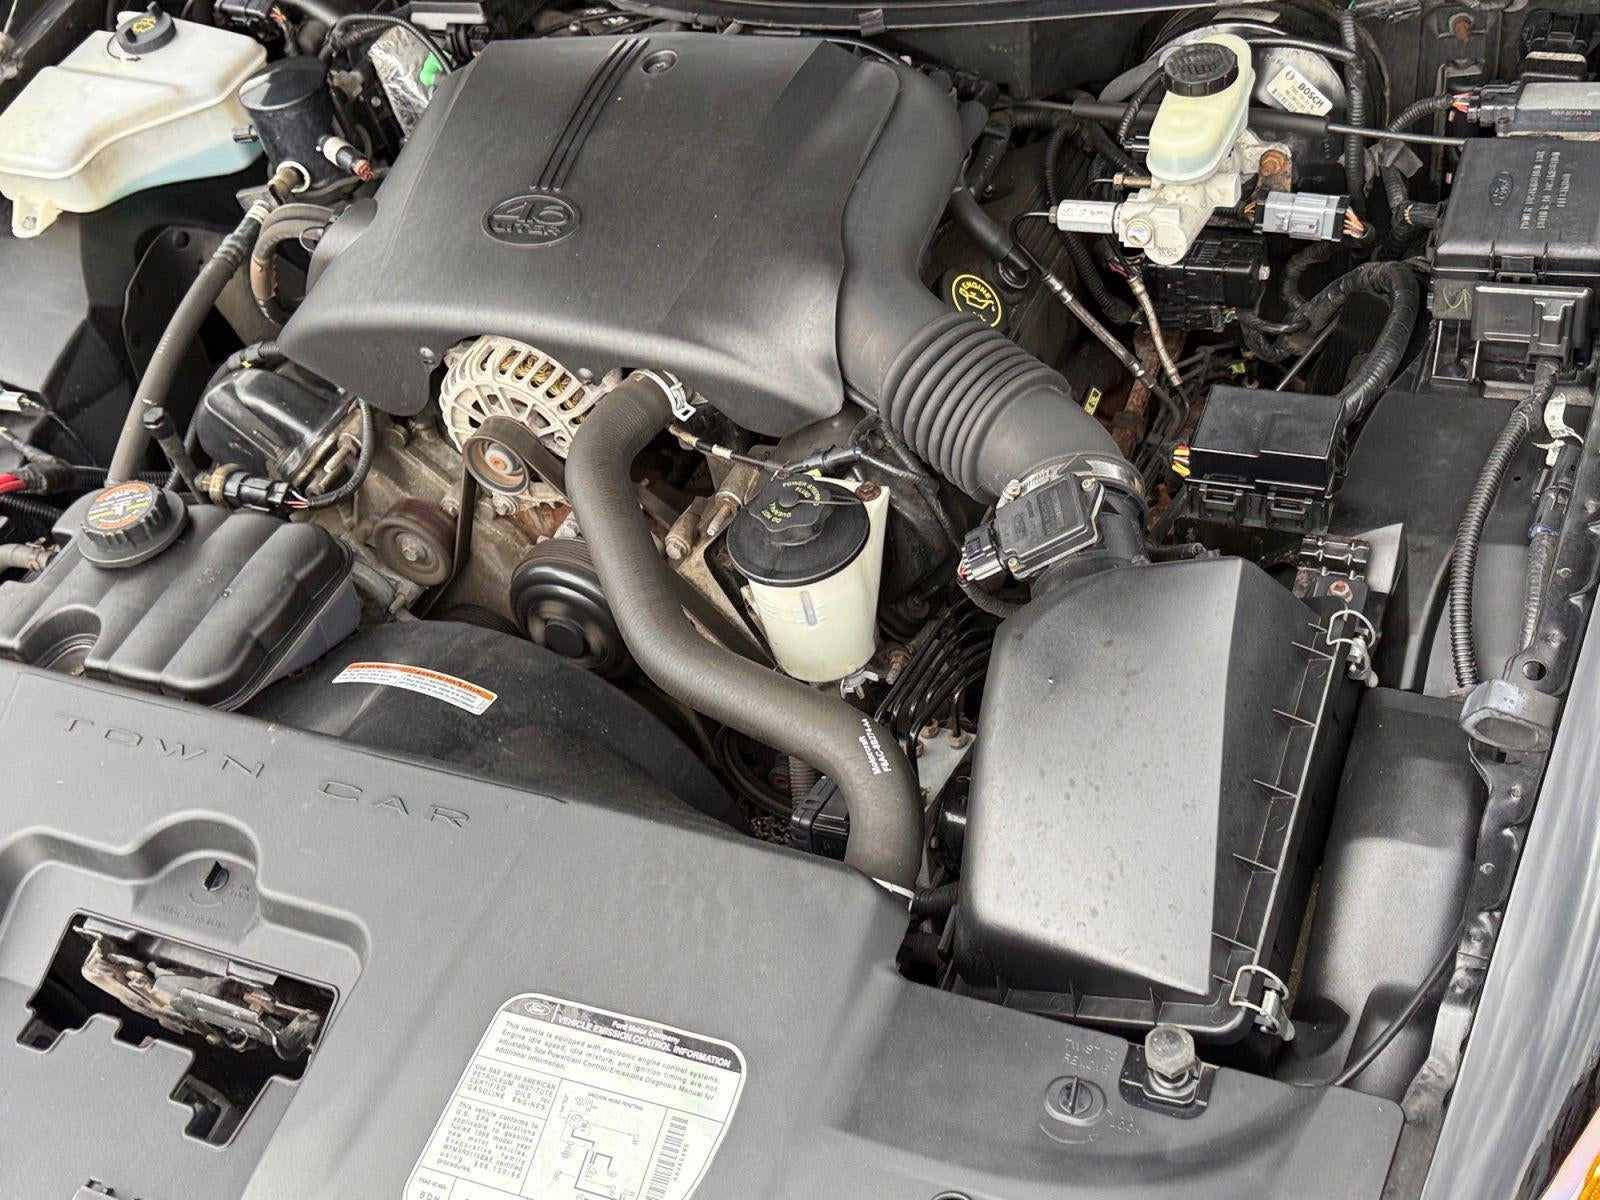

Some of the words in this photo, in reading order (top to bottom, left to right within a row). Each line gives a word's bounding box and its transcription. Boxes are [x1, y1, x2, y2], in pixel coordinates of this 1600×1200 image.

[1298, 82, 1325, 108] BOSCH
[961, 281, 992, 300] ENGINE
[782, 480, 808, 488] POWER
[771, 516, 782, 524] DO
[858, 735, 882, 775] Motorcraft
[56, 712, 265, 778] TOWN
[317, 781, 470, 829] CAR
[558, 1015, 592, 1030] VEHICLE
[593, 1024, 632, 1041] EMISSION
[632, 1035, 672, 1051] CONTROL
[673, 1046, 731, 1067] INFORMATION
[612, 1020, 627, 1031] Ford
[627, 1024, 648, 1036] Motor
[648, 1029, 680, 1046] Company
[495, 1046, 526, 1058] additional
[501, 1029, 525, 1040] Engine
[528, 1036, 541, 1044] idle
[570, 1047, 583, 1055] idle
[633, 1064, 660, 1076] ignition
[663, 1073, 686, 1083] timing
[505, 1021, 519, 1029] This
[521, 1025, 544, 1036] vehicle
[554, 1034, 584, 1047] equipped
[603, 1047, 635, 1060] electronic
[637, 1056, 660, 1067] engine
[662, 1063, 687, 1074] control
[689, 1070, 720, 1083] systems.
[472, 1070, 513, 1085] PETROLEUM
[517, 1083, 553, 1096] INSTITUTE
[489, 1067, 501, 1075] SAE
[523, 1076, 556, 1089] AMERICAN
[547, 1050, 581, 1063] Powertrain
[582, 1060, 643, 1080] Control/Emissions
[644, 1076, 677, 1090] Diagnosis
[678, 1086, 703, 1097] Manual
[467, 1084, 505, 1099] GASOLINE
[512, 1096, 545, 1110] ENGINES
[469, 1077, 505, 1091] CERTIFIED
[515, 1090, 531, 1098] OILS
[475, 1107, 496, 1116] vehicle
[499, 1114, 528, 1126] conforms
[475, 1114, 489, 1122] EPA
[494, 1121, 535, 1136] regulations
[453, 1117, 487, 1130] applicable
[504, 1131, 533, 1143] gasoline
[468, 1136, 488, 1145] motor
[492, 1135, 512, 1144] model
[496, 1160, 522, 1171] certified
[500, 1153, 525, 1165] family
